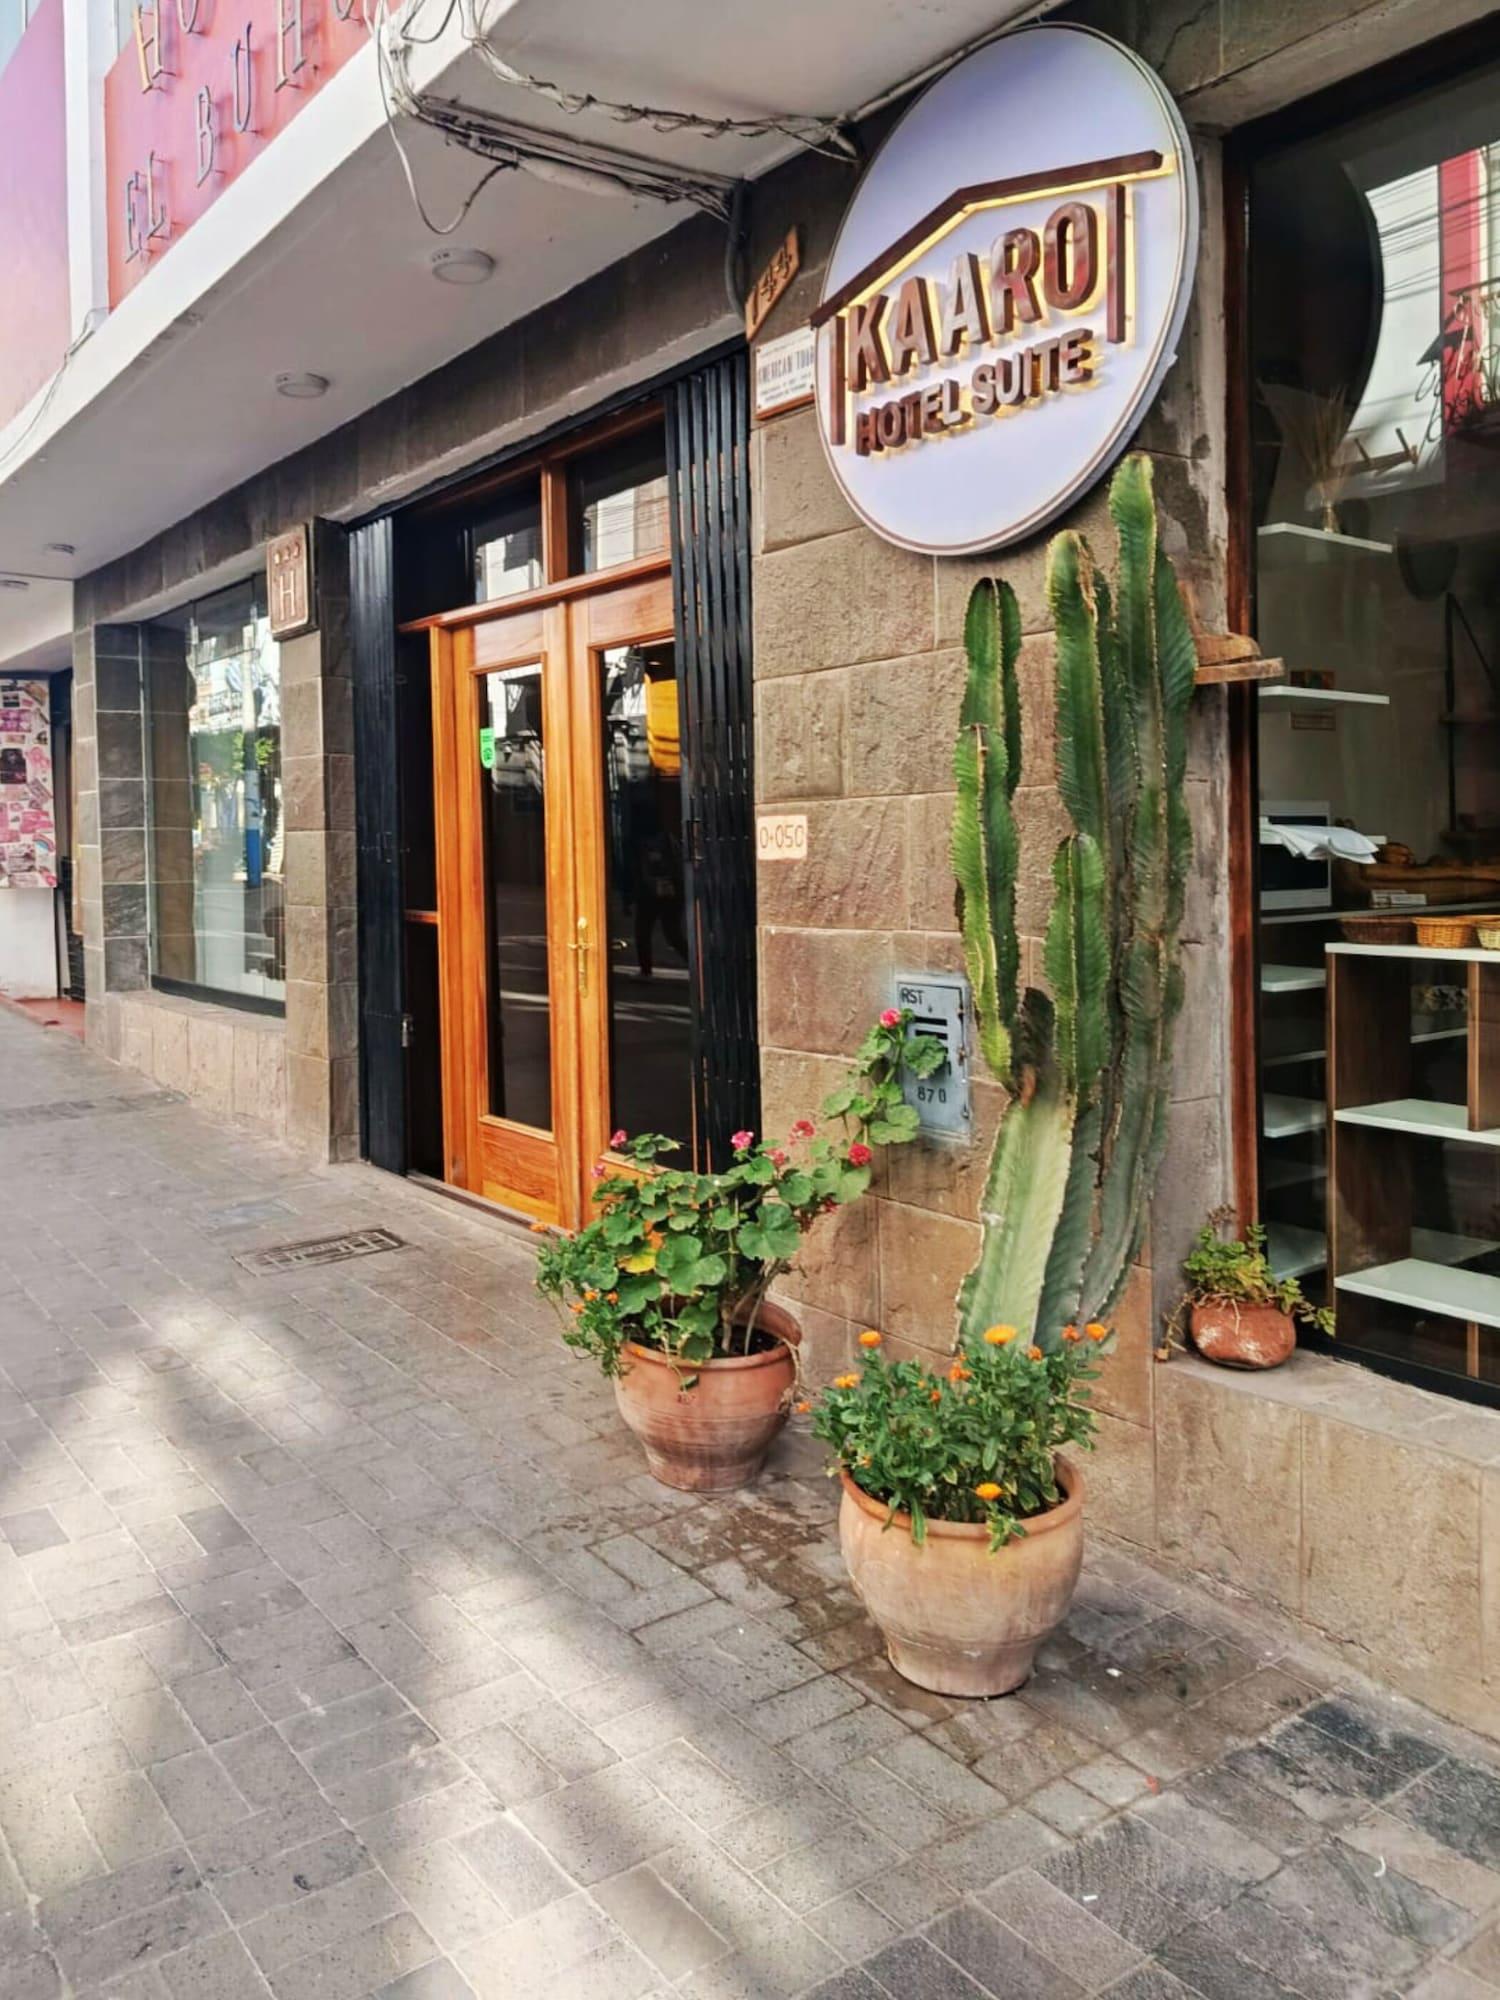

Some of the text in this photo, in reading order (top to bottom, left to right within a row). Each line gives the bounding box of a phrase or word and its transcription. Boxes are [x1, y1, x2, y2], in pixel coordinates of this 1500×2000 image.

[125, 0, 352, 264] EL BUH
[847, 201, 1098, 393] KAARO
[855, 327, 1094, 456] HOTEL SUITE
[900, 987, 925, 1005] RST
